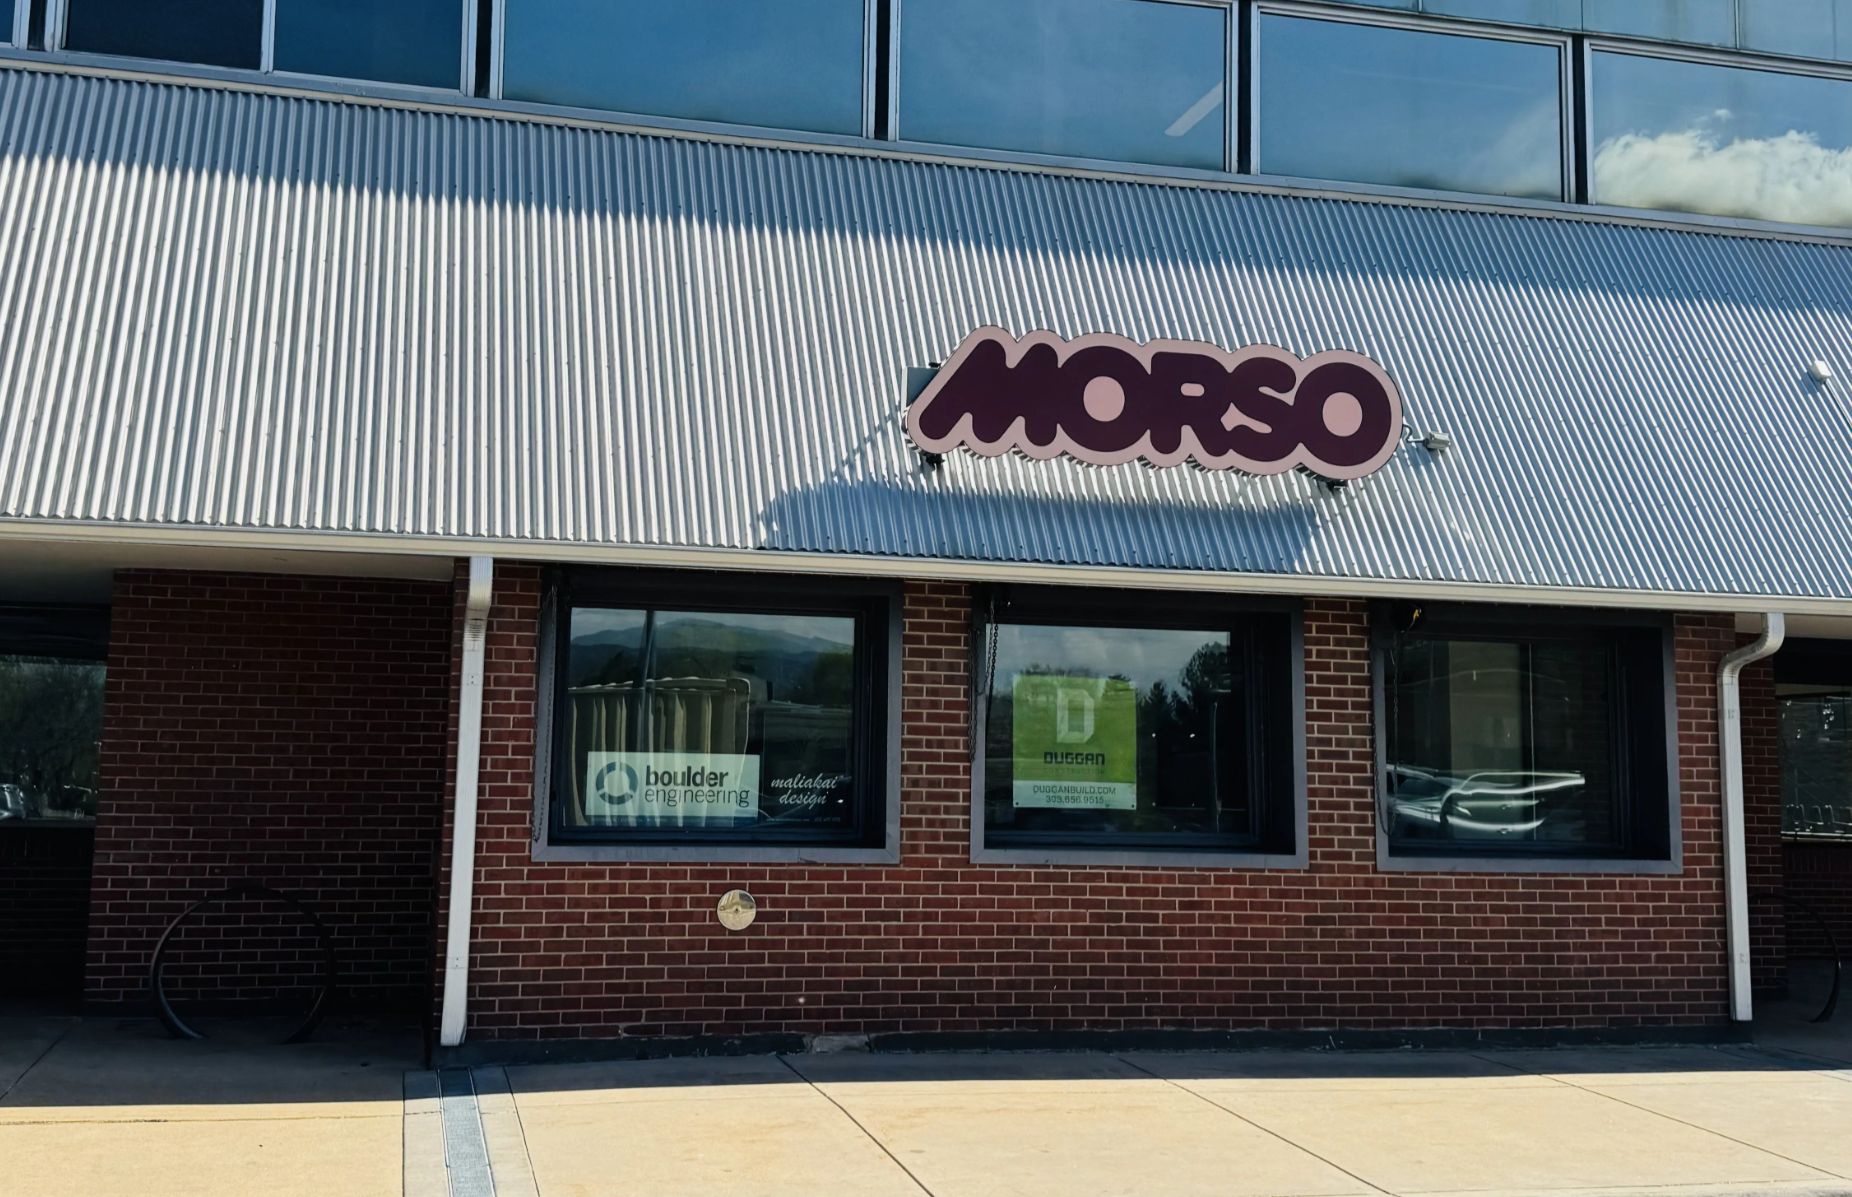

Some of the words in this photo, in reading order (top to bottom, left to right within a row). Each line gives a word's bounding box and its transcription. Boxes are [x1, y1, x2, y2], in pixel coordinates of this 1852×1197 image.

[918, 338, 1392, 467] MORSO
[1056, 688, 1095, 744] D
[1043, 751, 1106, 767] DUGGAN
[645, 764, 729, 787] boulder
[770, 772, 838, 789] maliakai
[644, 788, 751, 808] engineering
[779, 788, 828, 810] design
